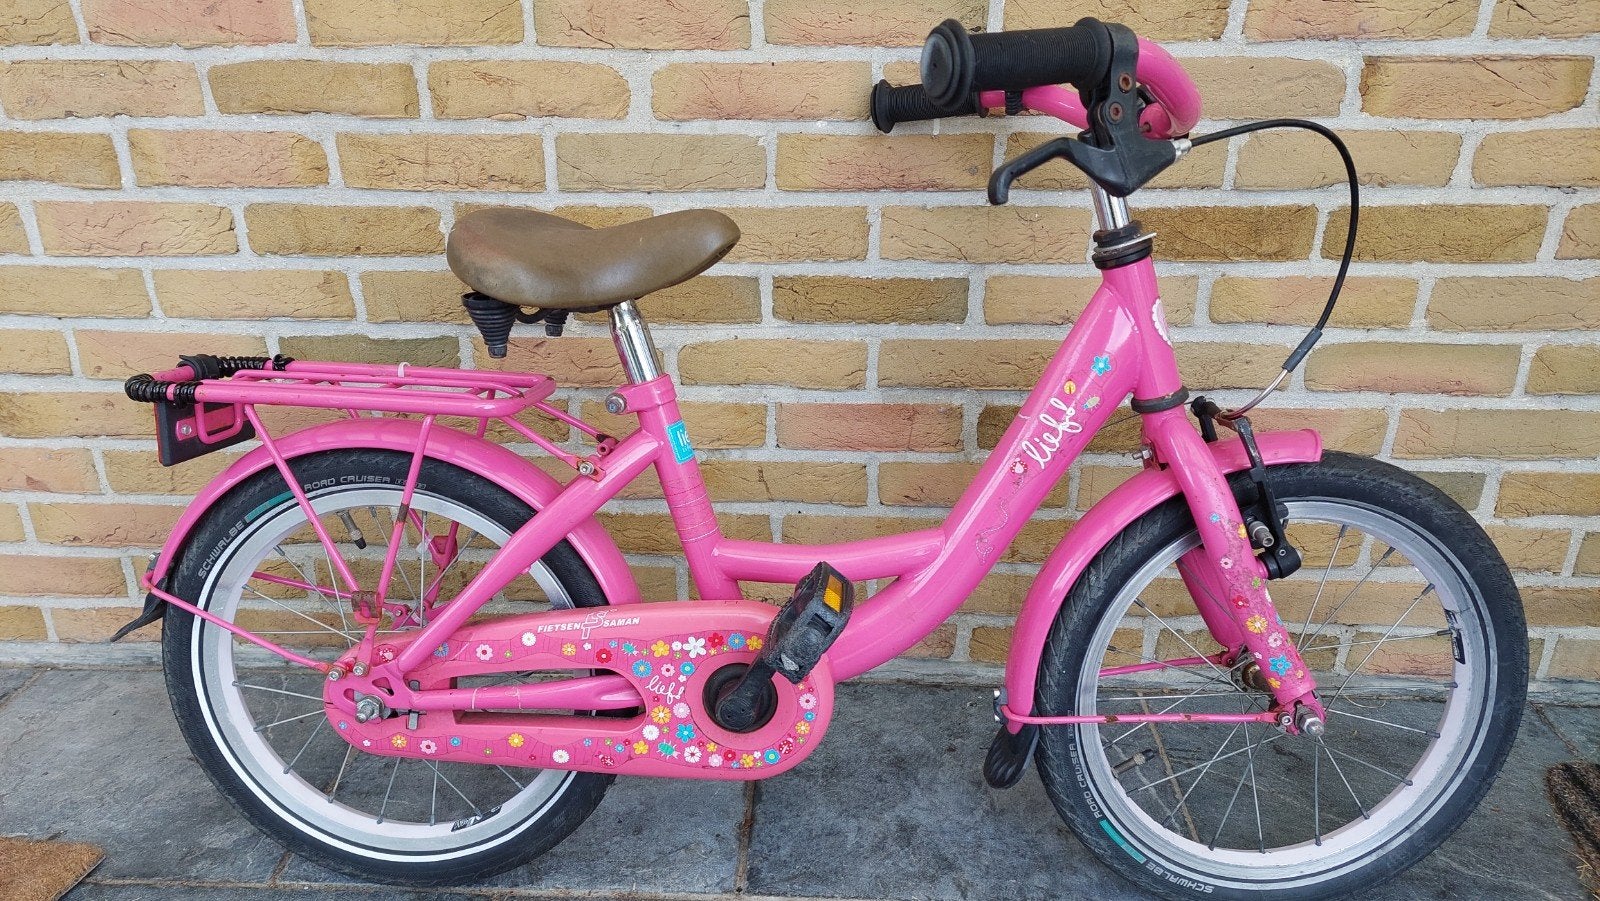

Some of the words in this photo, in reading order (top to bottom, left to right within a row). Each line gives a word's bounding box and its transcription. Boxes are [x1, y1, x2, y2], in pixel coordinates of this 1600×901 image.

[303, 477, 336, 492] ROAD
[339, 474, 391, 484] CRUISER
[197, 521, 245, 580] SCHWALBE
[537, 622, 581, 633] FIETSEN
[603, 616, 641, 628] SAMAN
[1068, 743, 1087, 788] CRUISER
[1083, 791, 1103, 819] ROAD
[1145, 862, 1216, 894] SCHWALBE
